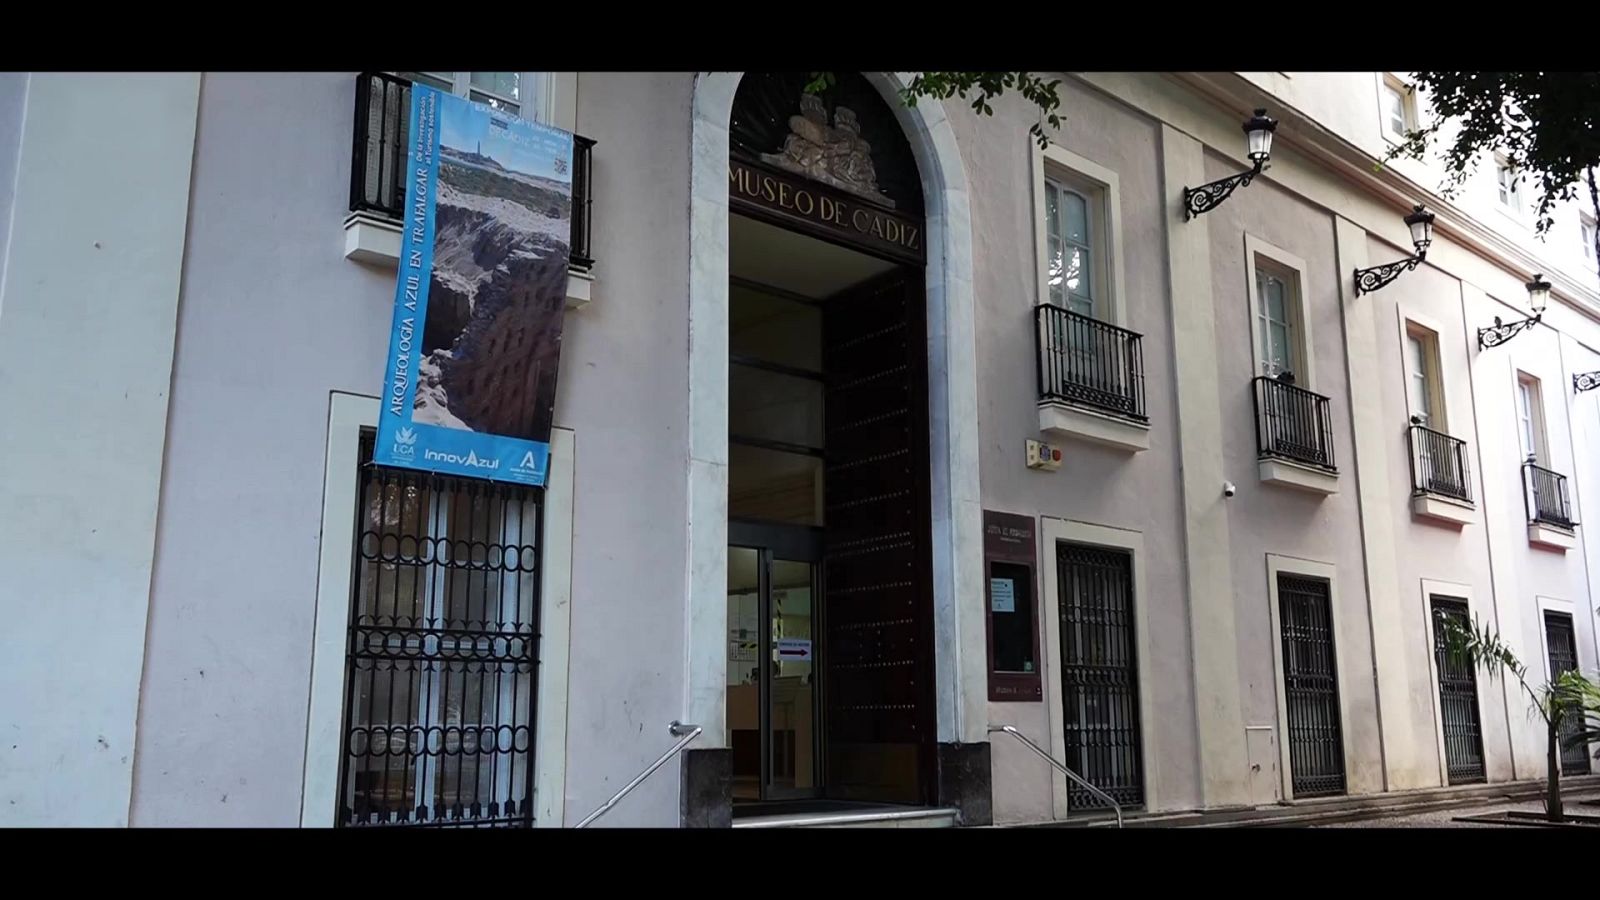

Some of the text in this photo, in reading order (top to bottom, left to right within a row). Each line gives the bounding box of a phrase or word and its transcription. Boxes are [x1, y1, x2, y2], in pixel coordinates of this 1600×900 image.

[425, 128, 434, 156] Turismo
[412, 168, 428, 245] TRAFALGAR
[729, 165, 919, 249] MUSEO DE CADIZ
[409, 249, 422, 269] EN
[404, 274, 420, 312] AZUL
[393, 443, 414, 455] UCA
[424, 448, 499, 469] InnovAzul
